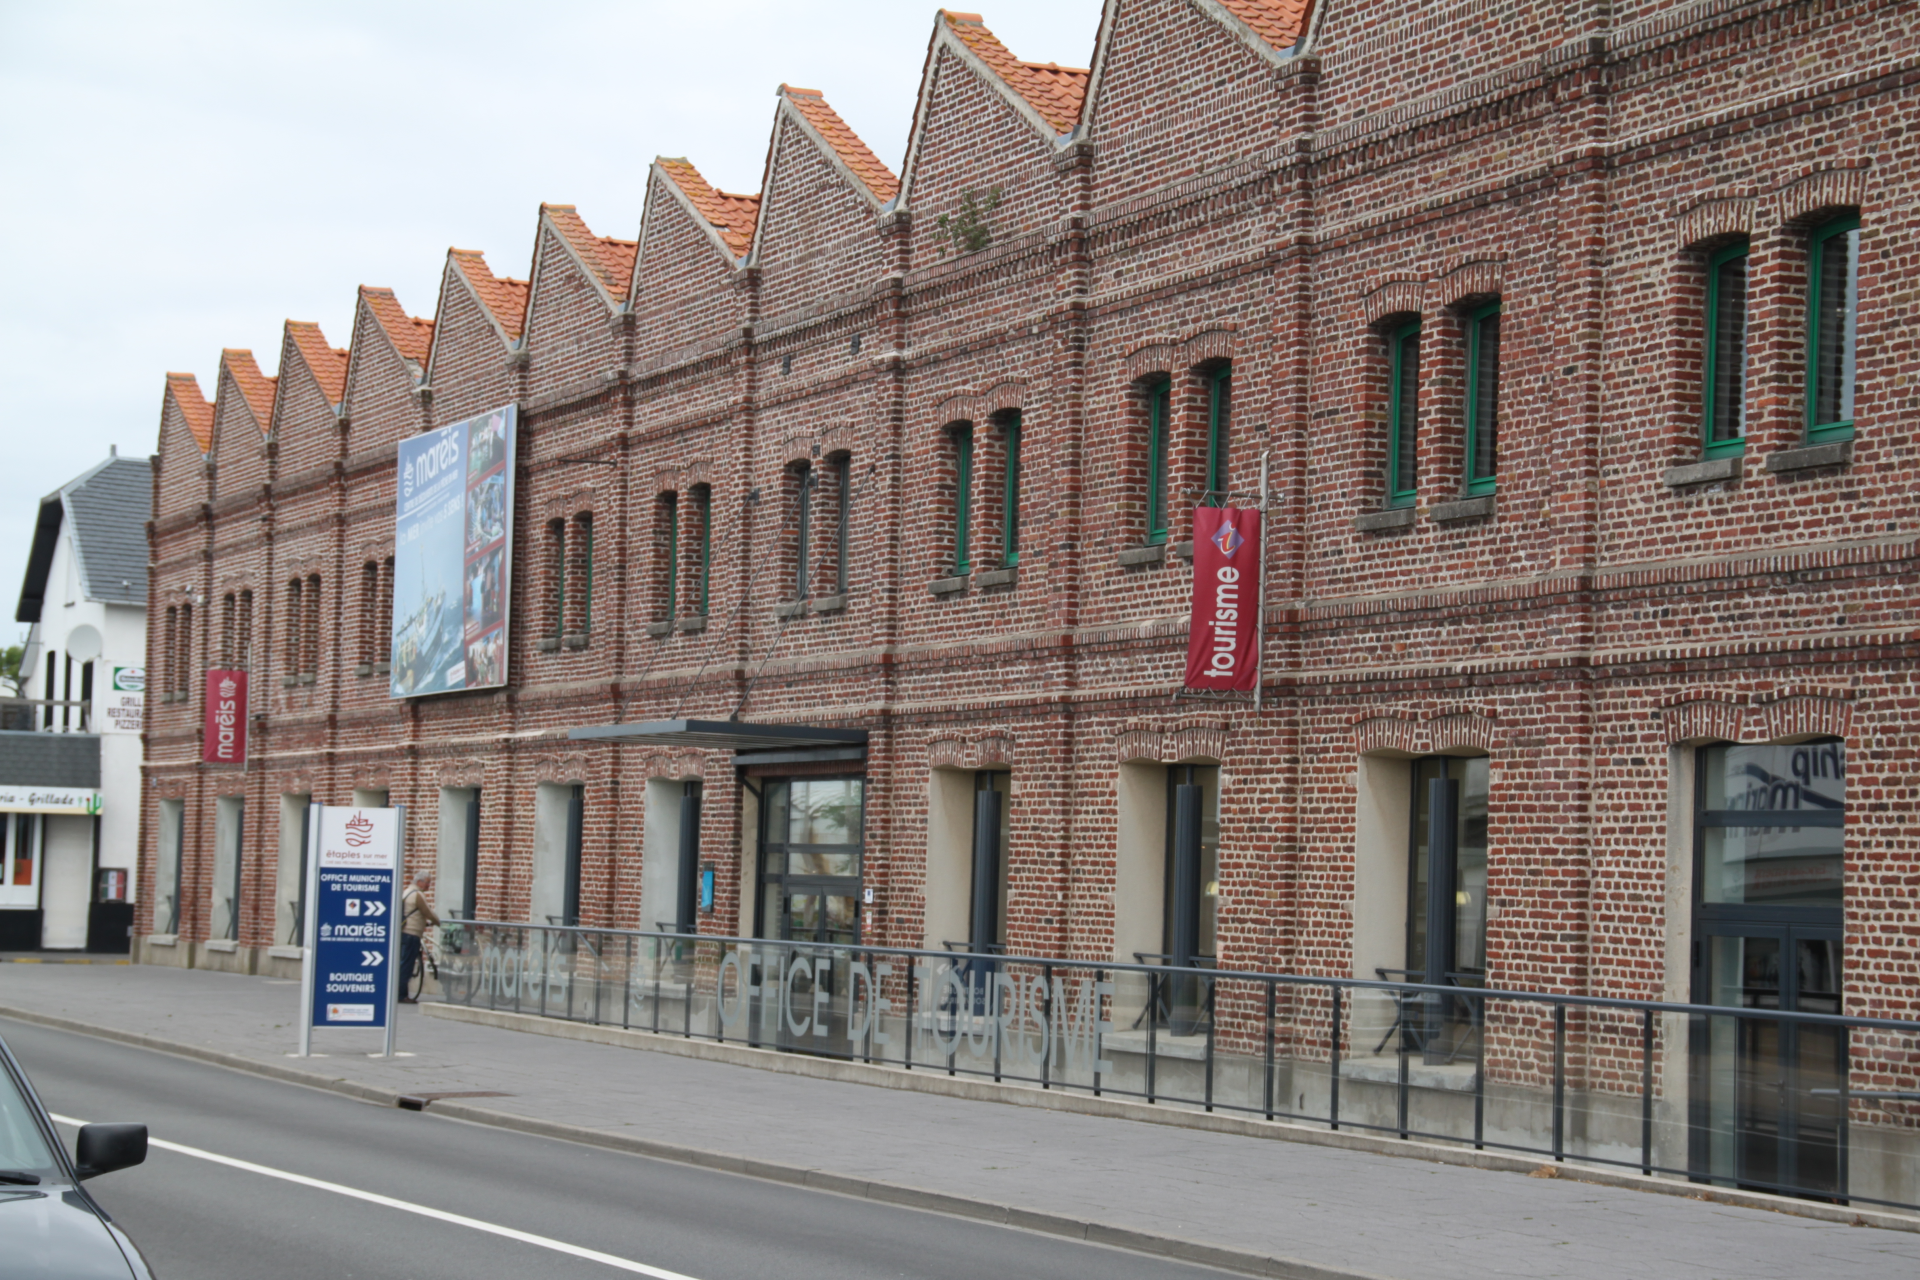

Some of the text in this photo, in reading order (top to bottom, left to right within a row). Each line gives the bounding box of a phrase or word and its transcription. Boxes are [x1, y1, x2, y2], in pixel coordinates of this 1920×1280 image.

[1203, 566, 1240, 678] tourisme
[120, 696, 142, 707] GRILL
[28, 792, 74, 806] Grillade
[320, 873, 391, 883] OFFICE MUNICIPAL
[331, 883, 380, 893] DE TOURISME
[329, 972, 374, 982] BOUTIQUE
[326, 983, 376, 993] SOUVENIRS
[718, 951, 1116, 1074] OFFICE DE TOURISME
